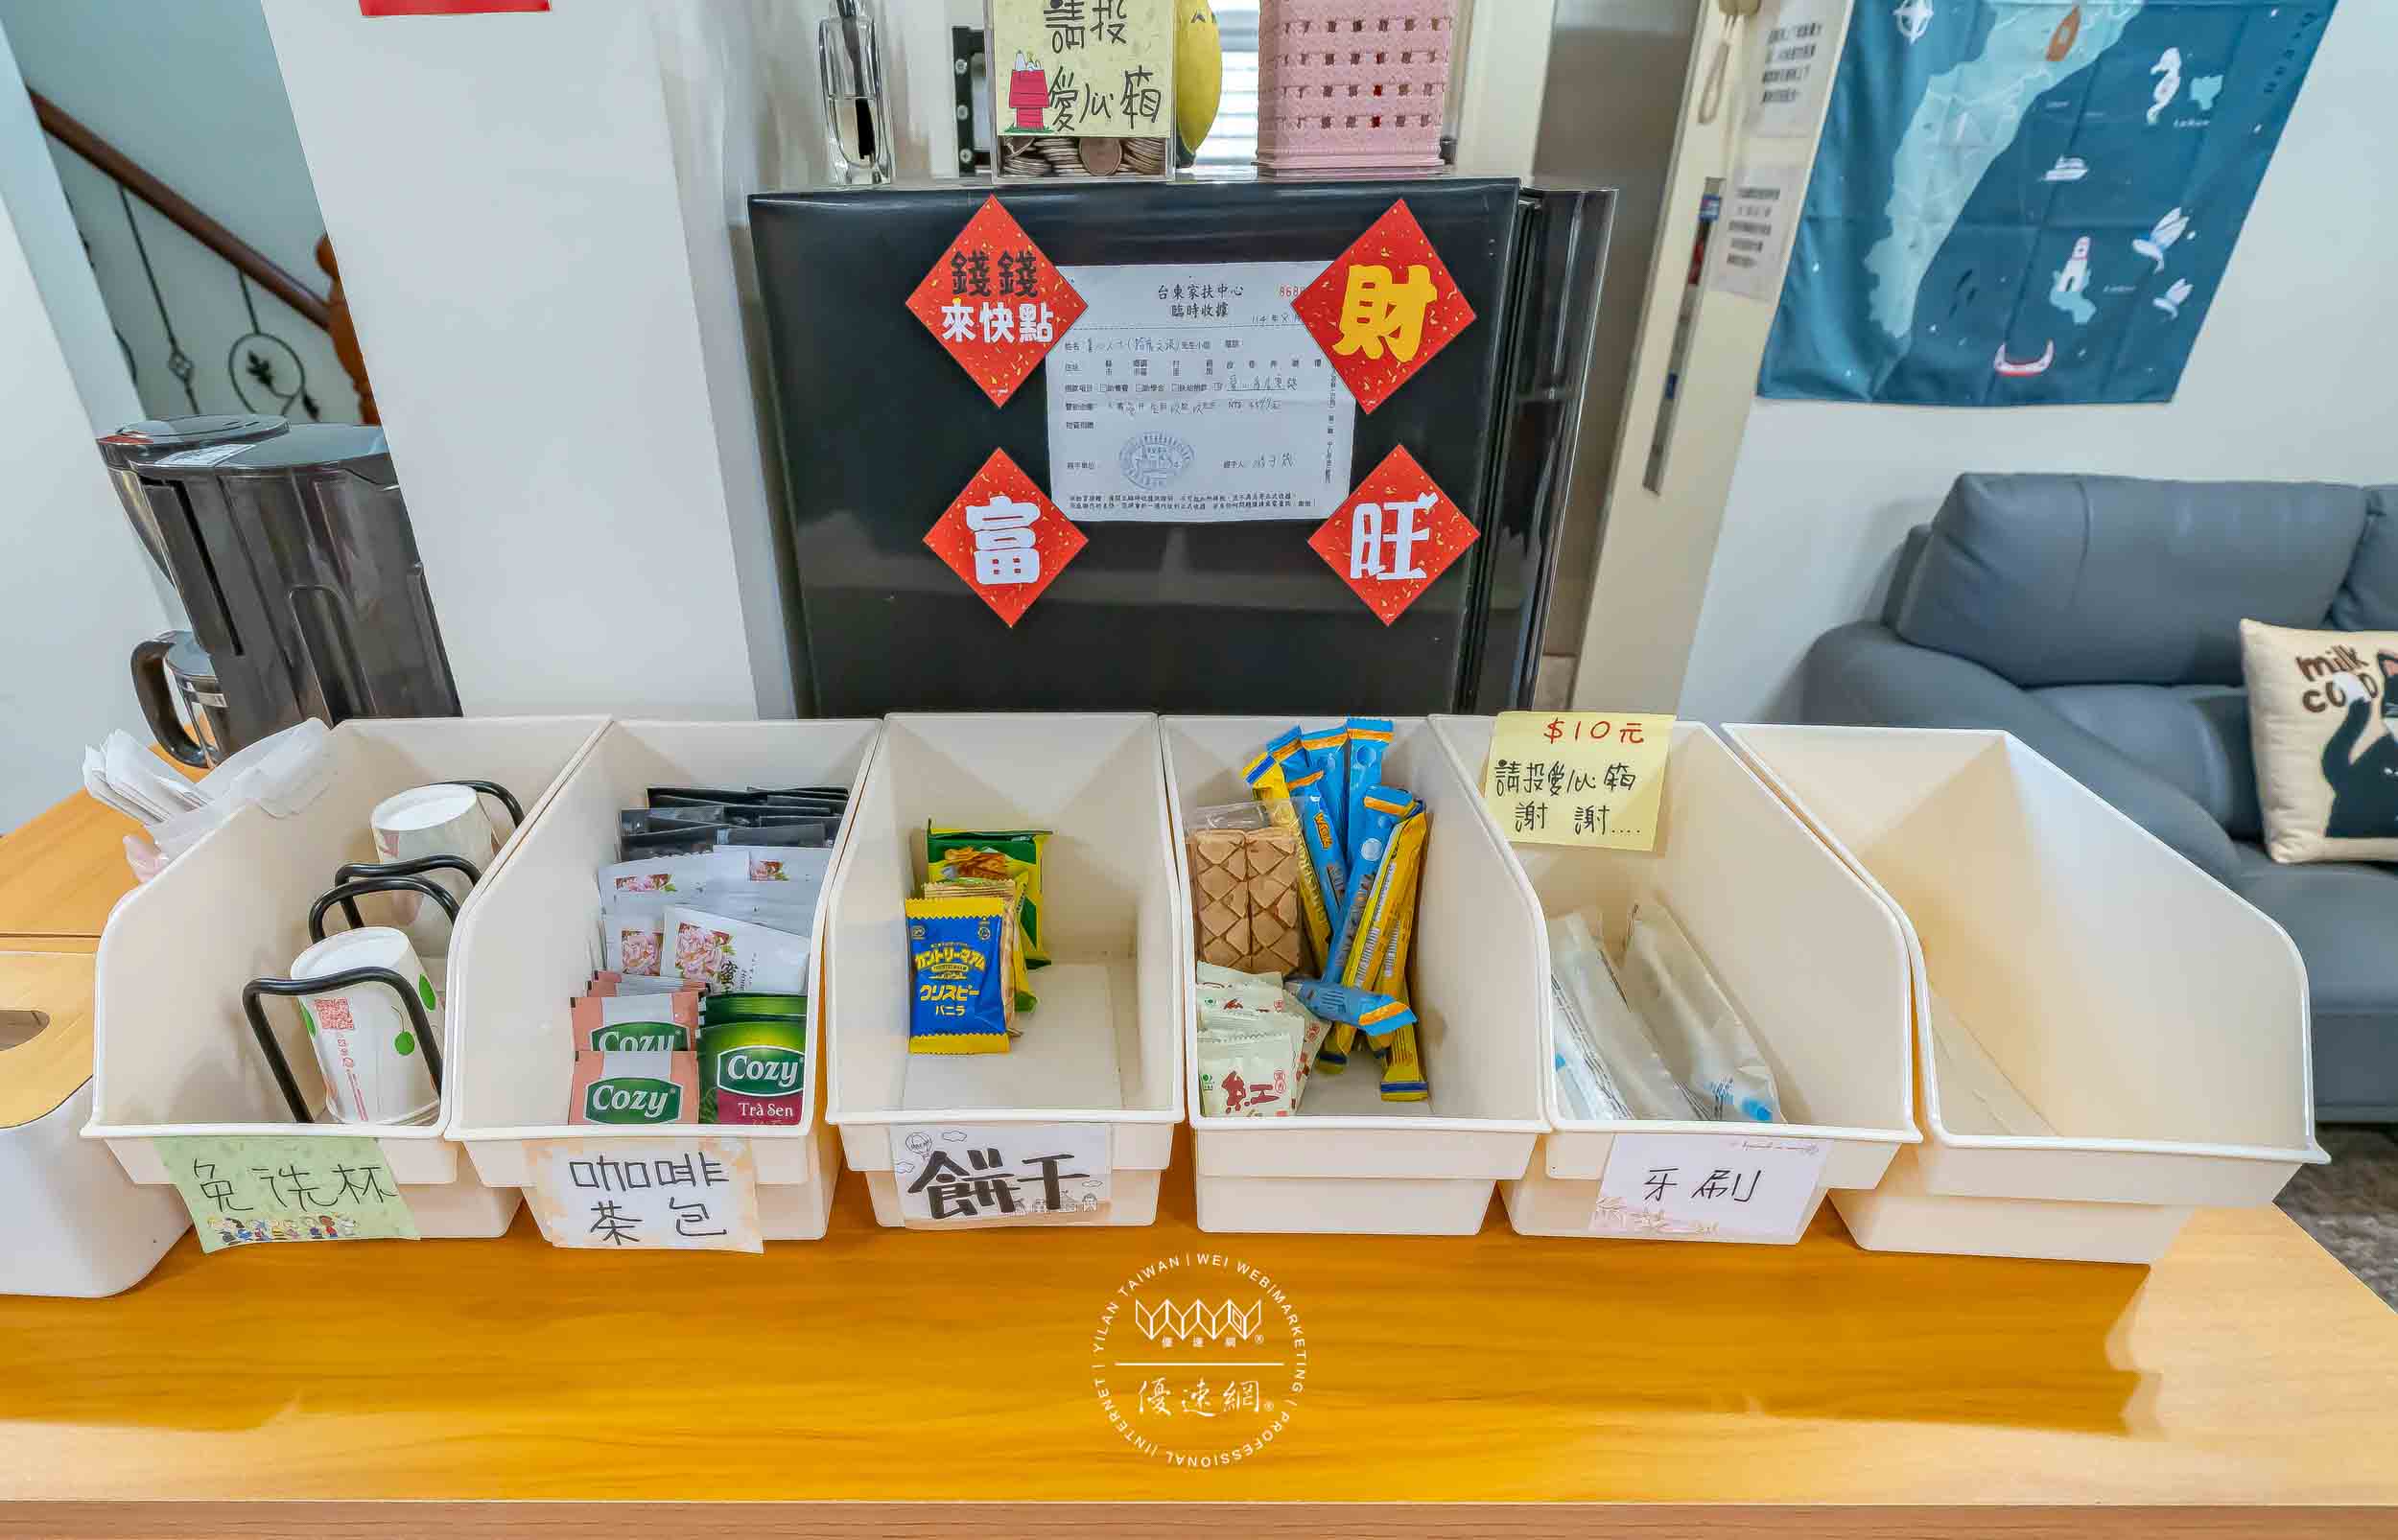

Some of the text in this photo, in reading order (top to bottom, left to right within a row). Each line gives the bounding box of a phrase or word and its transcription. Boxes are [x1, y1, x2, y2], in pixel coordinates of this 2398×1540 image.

[1048, 65, 1162, 131] 愛心箱
[951, 250, 1038, 297] 錢錢
[1158, 284, 1244, 300] 台東家扶中心
[940, 301, 1054, 343] 來快點
[1171, 302, 1229, 318] 臨時收據
[1332, 264, 1438, 362] 財
[965, 495, 1041, 585] 富
[1350, 492, 1439, 581] 旺
[2295, 644, 2369, 682] milk
[1494, 758, 1636, 797] 請投愛心箱
[920, 984, 980, 1002] クリスピー
[935, 1004, 966, 1016] バニラ
[726, 1054, 801, 1087] Cozy
[592, 1085, 670, 1118] Cozy
[738, 1102, 793, 1117] Trà Sen
[569, 1151, 731, 1192] 咖啡
[1644, 1168, 1762, 1202] 牙刷
[590, 1196, 729, 1246] 茶包
